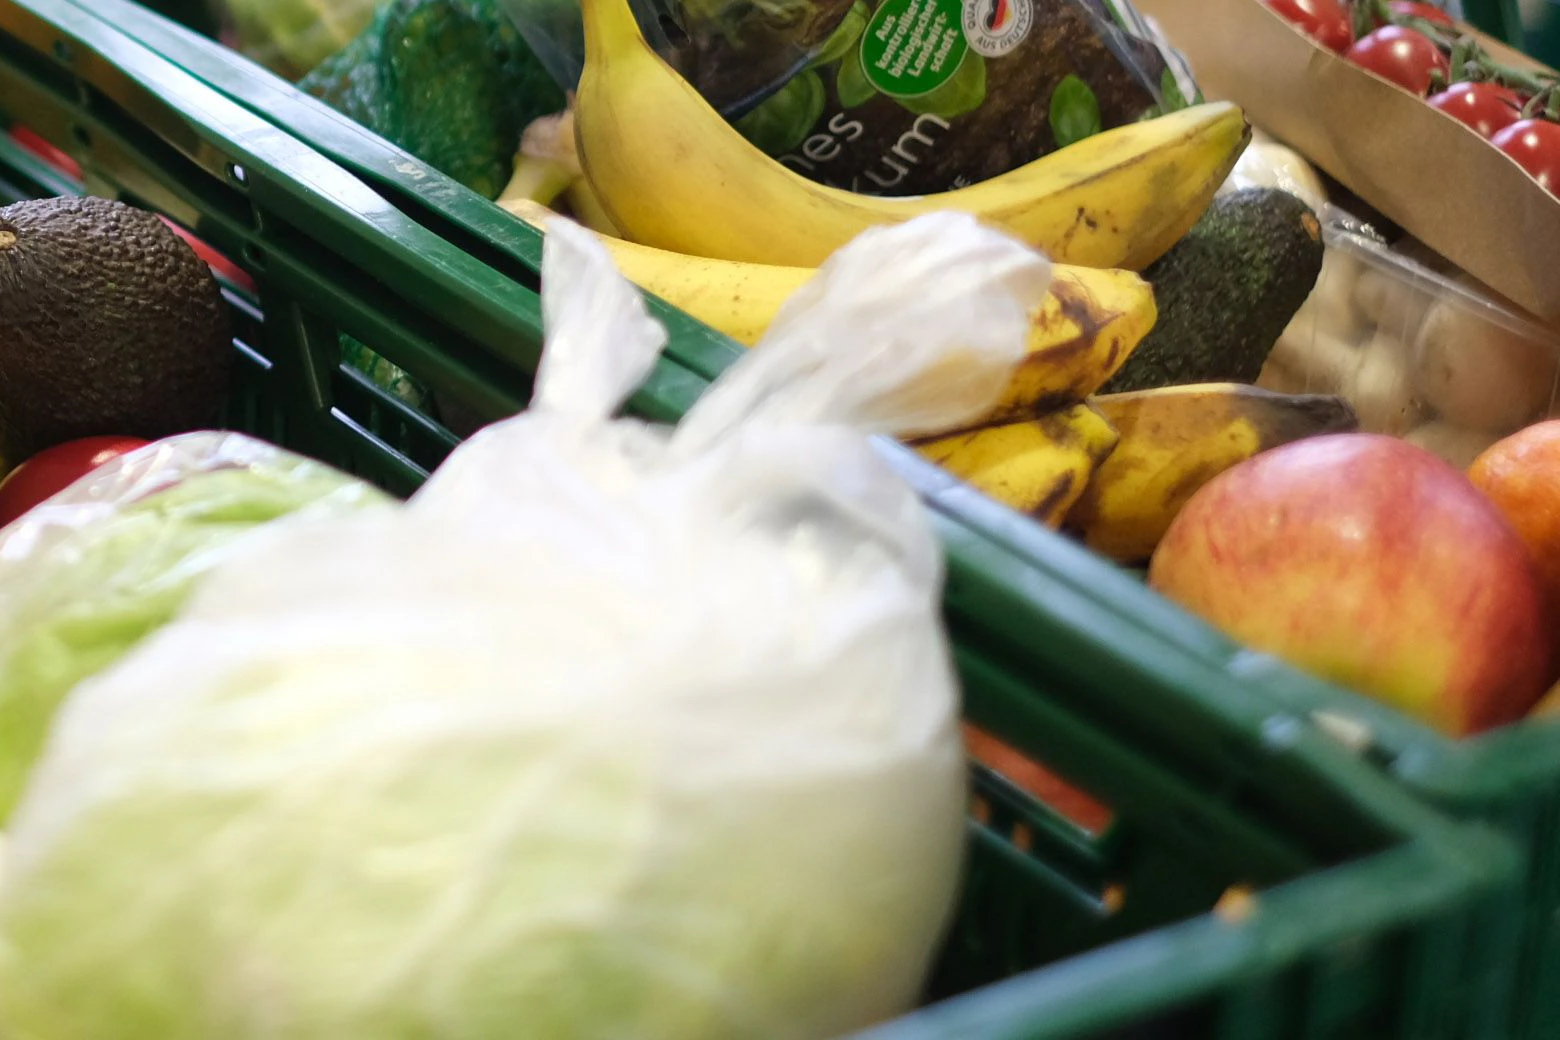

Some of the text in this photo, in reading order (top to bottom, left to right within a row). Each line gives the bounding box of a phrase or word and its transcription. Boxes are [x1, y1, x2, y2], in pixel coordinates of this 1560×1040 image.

[875, 14, 896, 42] Aus
[906, 11, 947, 78] Landwirt-
[975, 35, 996, 50] AUS
[930, 27, 958, 73] schaft
